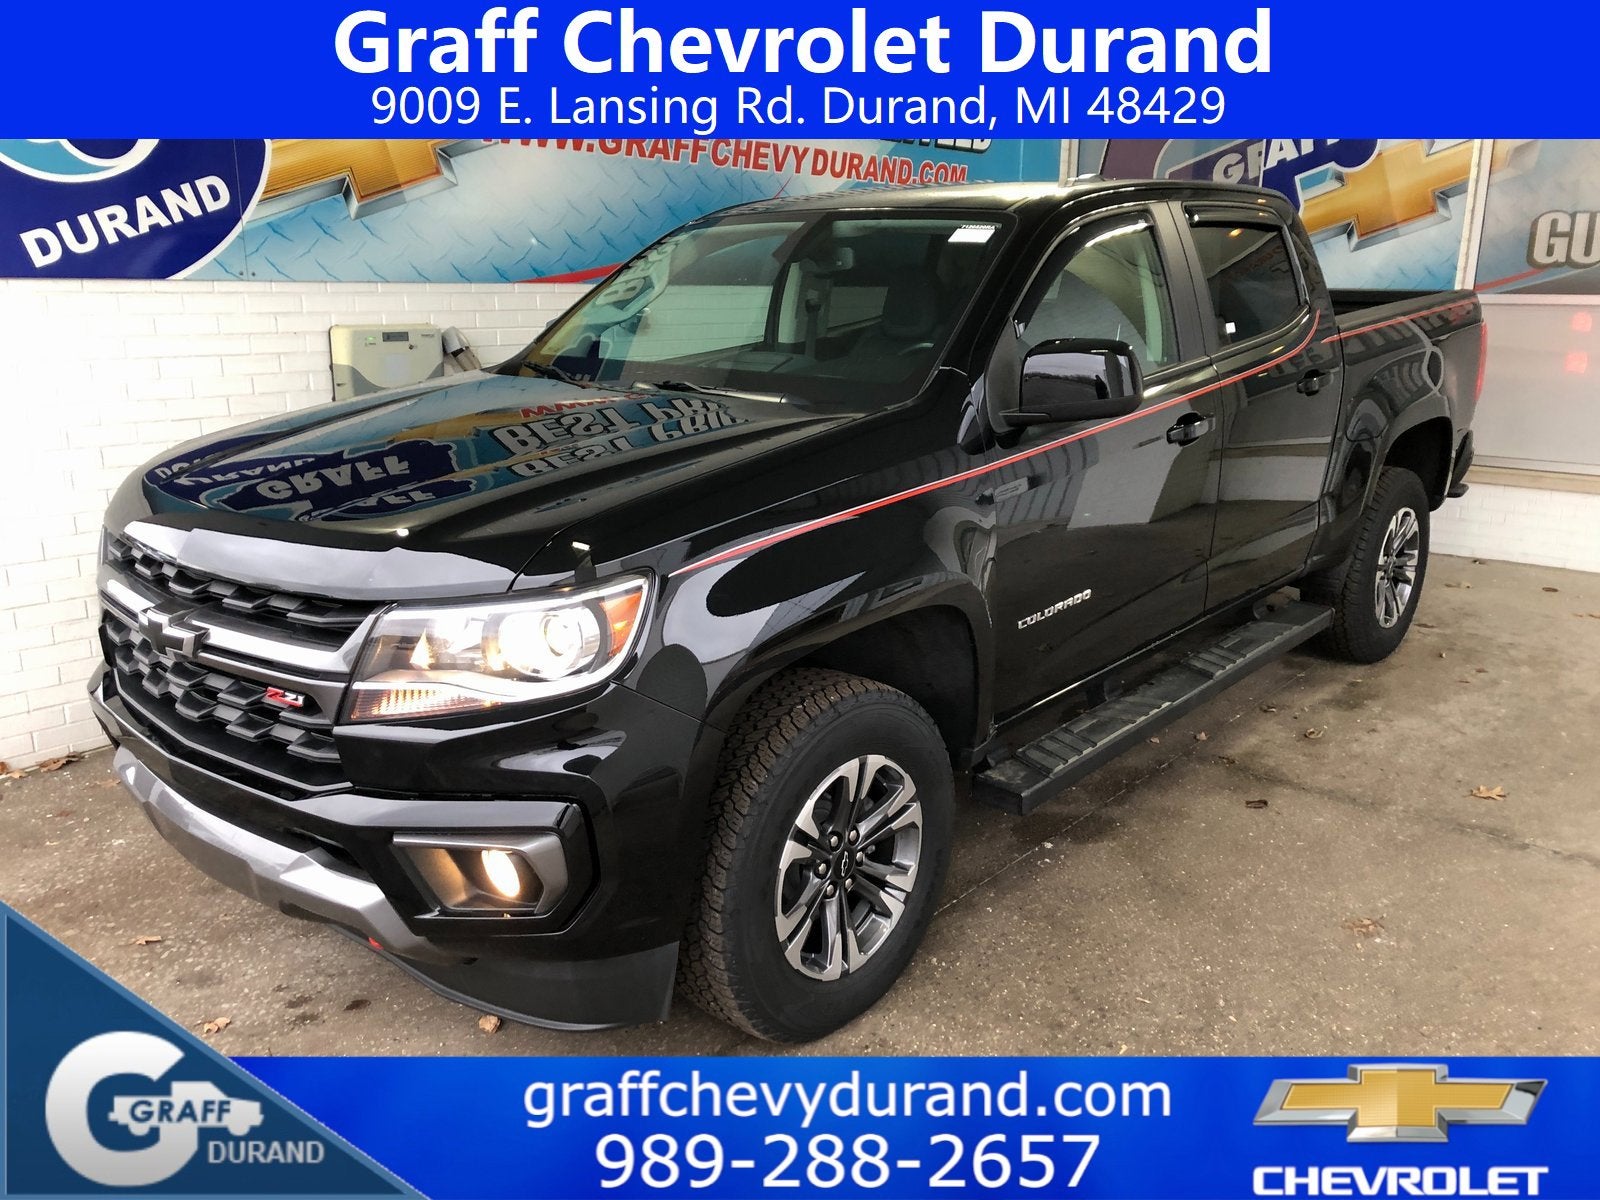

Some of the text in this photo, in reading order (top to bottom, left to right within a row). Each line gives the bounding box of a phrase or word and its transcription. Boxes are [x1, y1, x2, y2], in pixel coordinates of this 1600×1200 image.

[481, 138, 968, 185] .GRAFFCHEVYDURAND.COM
[19, 175, 231, 269] DURAND
[1531, 210, 1600, 265] GU
[1017, 588, 1092, 630] COLORADO
[263, 686, 305, 708] Z71
